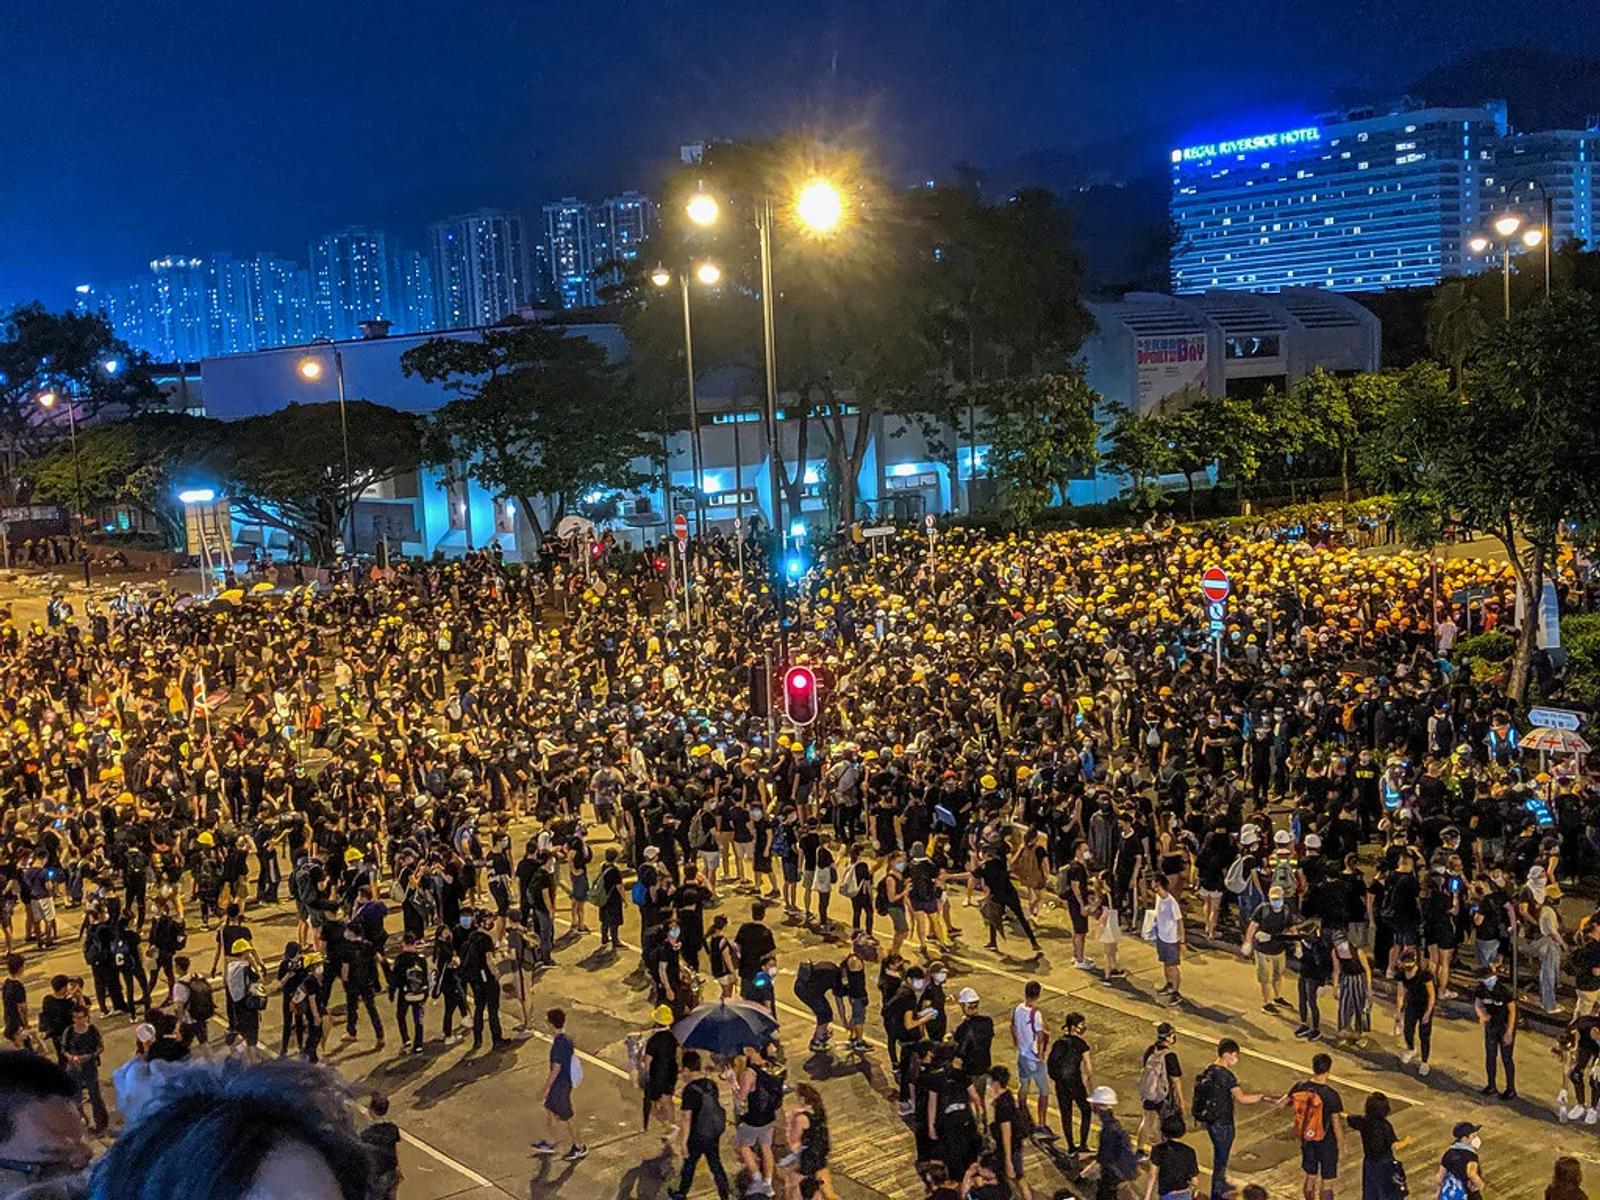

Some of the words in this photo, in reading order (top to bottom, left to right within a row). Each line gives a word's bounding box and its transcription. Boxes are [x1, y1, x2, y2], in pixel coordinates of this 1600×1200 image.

[1183, 144, 1217, 160] REGAL
[1219, 133, 1278, 154] RIVERSIDE
[1280, 127, 1320, 145] HOTEL
